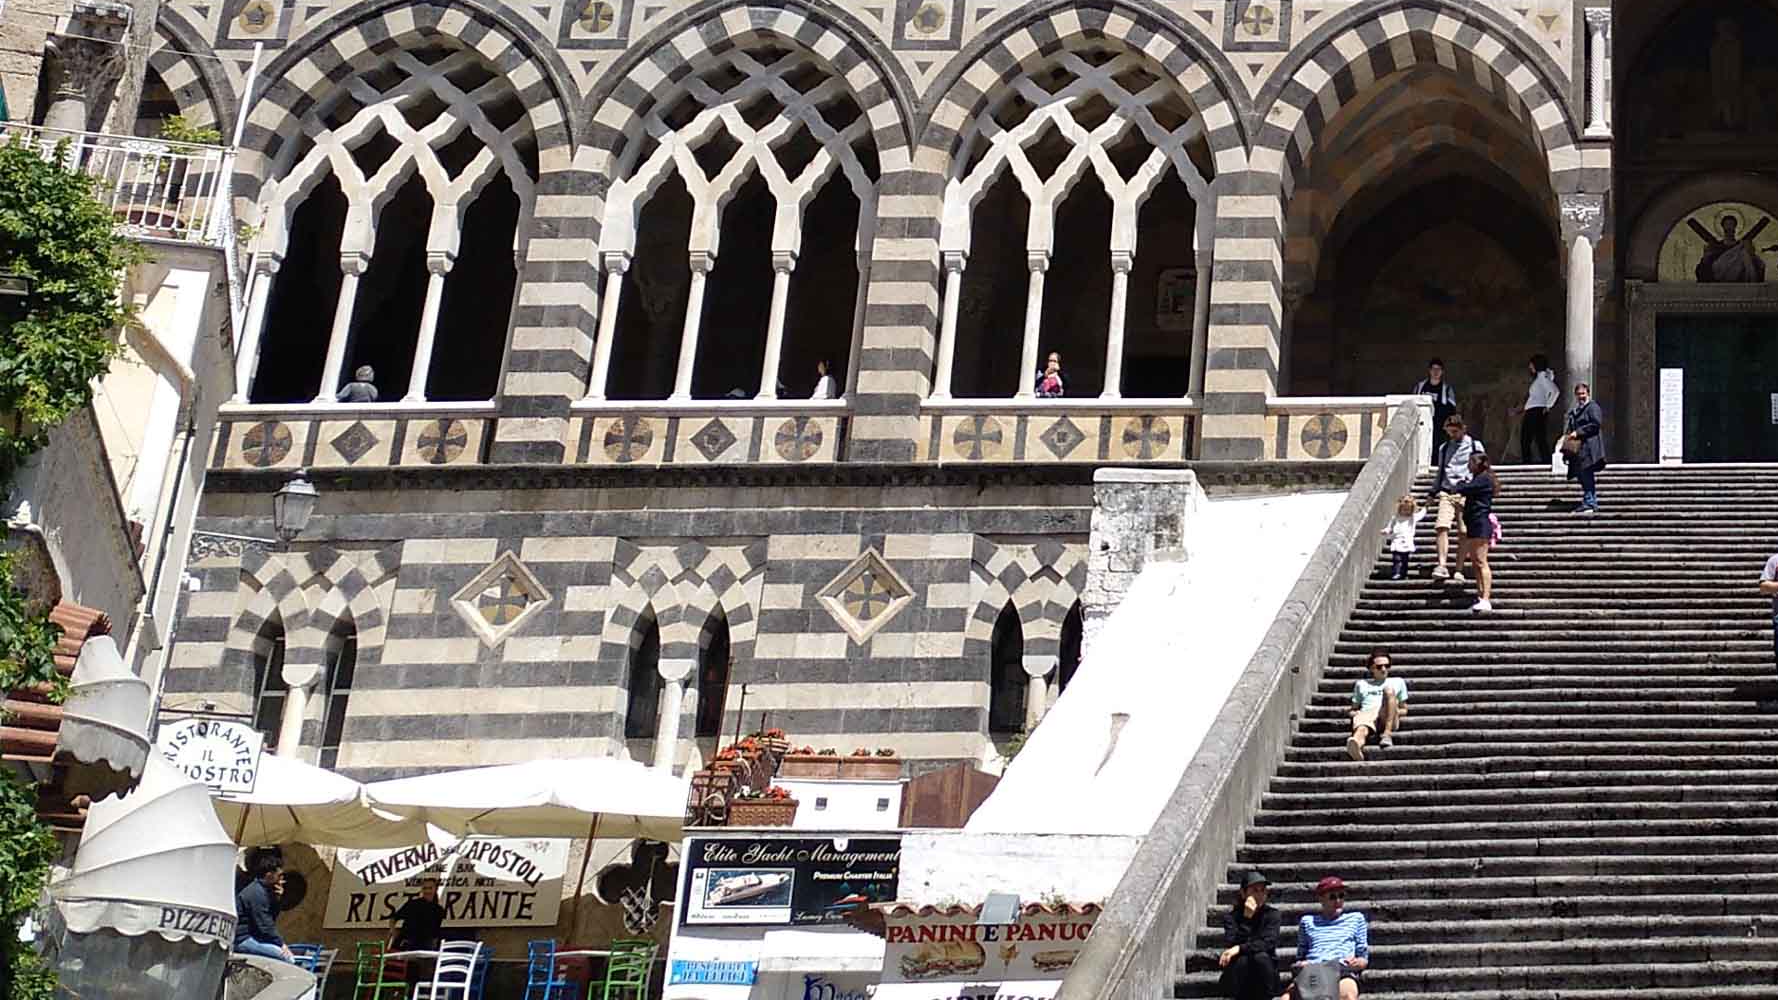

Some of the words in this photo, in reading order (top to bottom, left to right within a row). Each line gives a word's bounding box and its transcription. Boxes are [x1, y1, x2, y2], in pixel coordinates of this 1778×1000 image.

[202, 750, 214, 762] IL
[357, 842, 439, 887] TAVERNA
[465, 840, 544, 889] APOSTOLI
[703, 842, 739, 863] Elite
[742, 843, 794, 865] Yacht
[796, 842, 901, 869] Management
[346, 890, 538, 923] RISTRANTE
[886, 924, 977, 943] PANINI
[983, 923, 1000, 943] E
